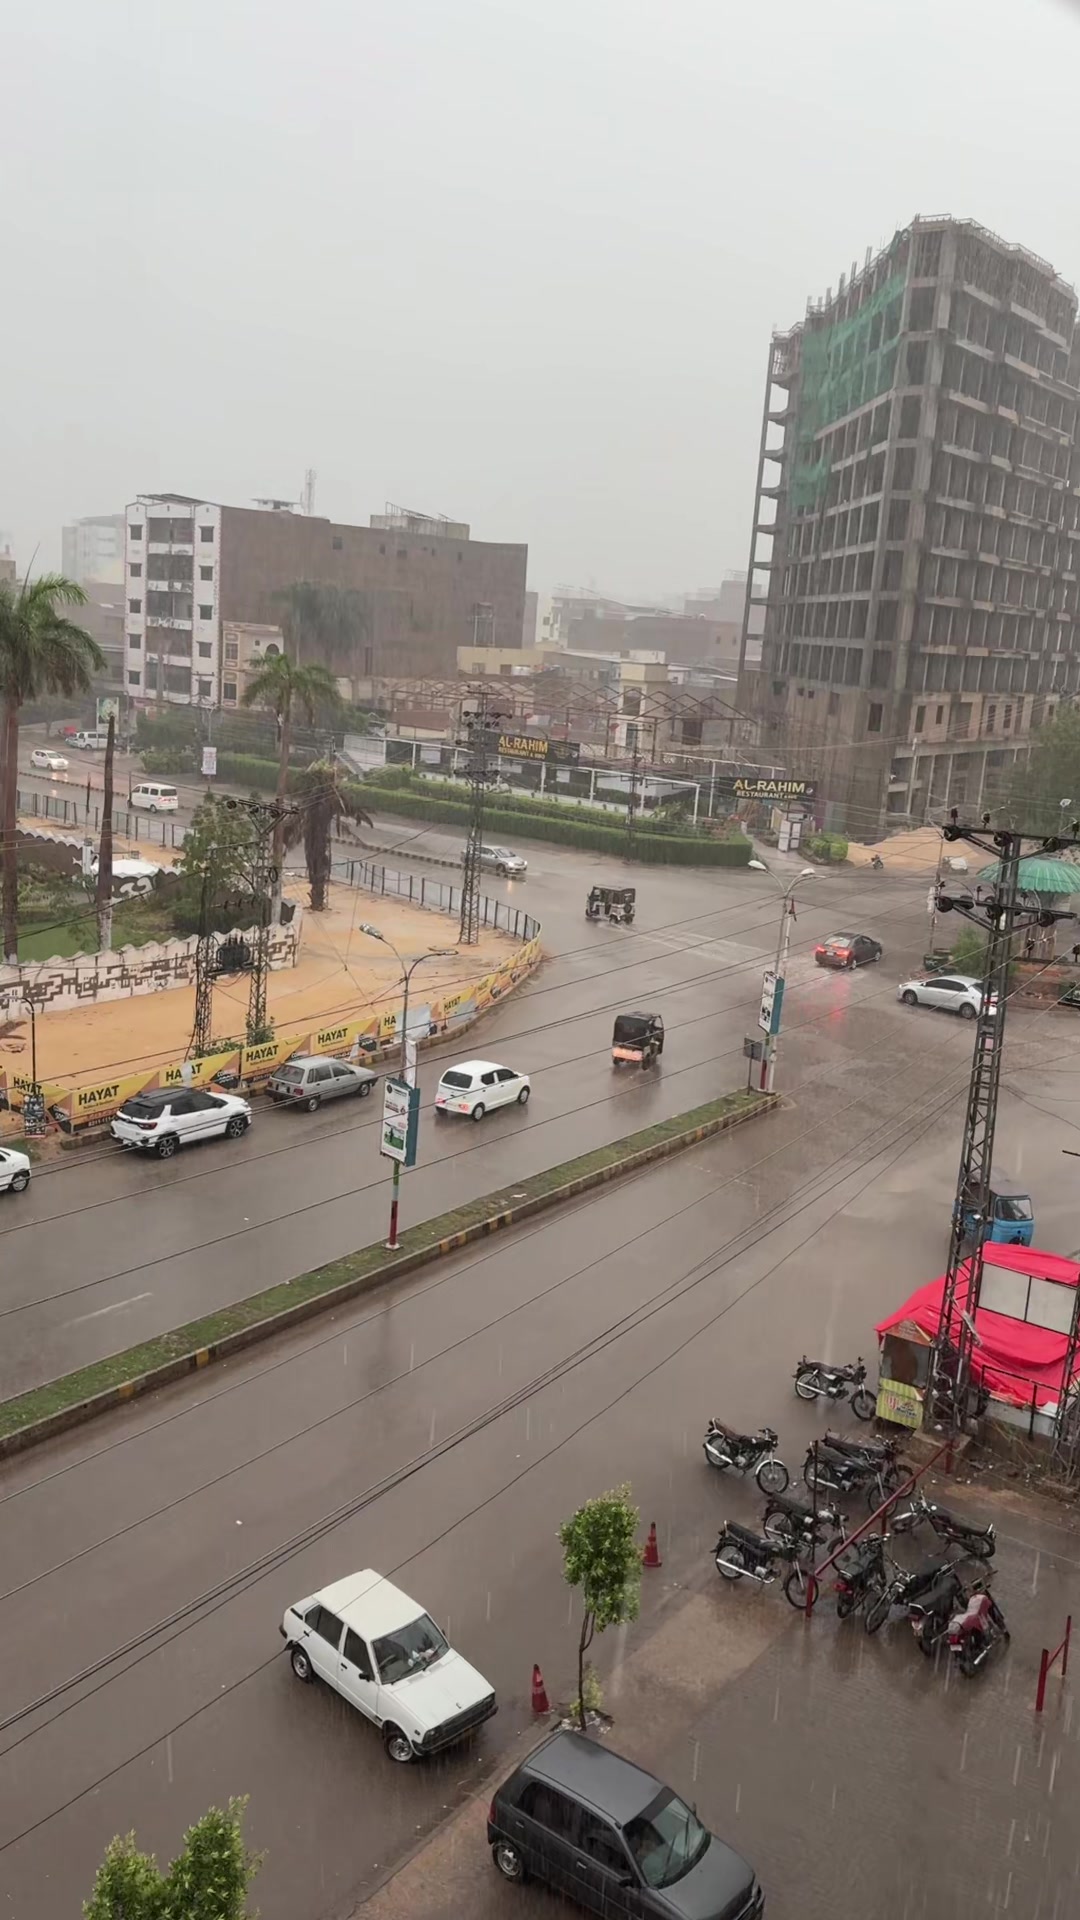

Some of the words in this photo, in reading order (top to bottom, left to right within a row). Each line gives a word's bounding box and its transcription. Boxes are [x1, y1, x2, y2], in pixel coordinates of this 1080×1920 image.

[499, 735, 549, 754] AL-RAHIM
[733, 779, 806, 794] AL-RAHIM
[736, 789, 784, 799] RESTAURANT
[317, 1028, 349, 1045] HAYAT
[246, 1045, 279, 1063] HAYAT
[166, 1062, 203, 1082] HAAT
[78, 1084, 120, 1106] HAYAT
